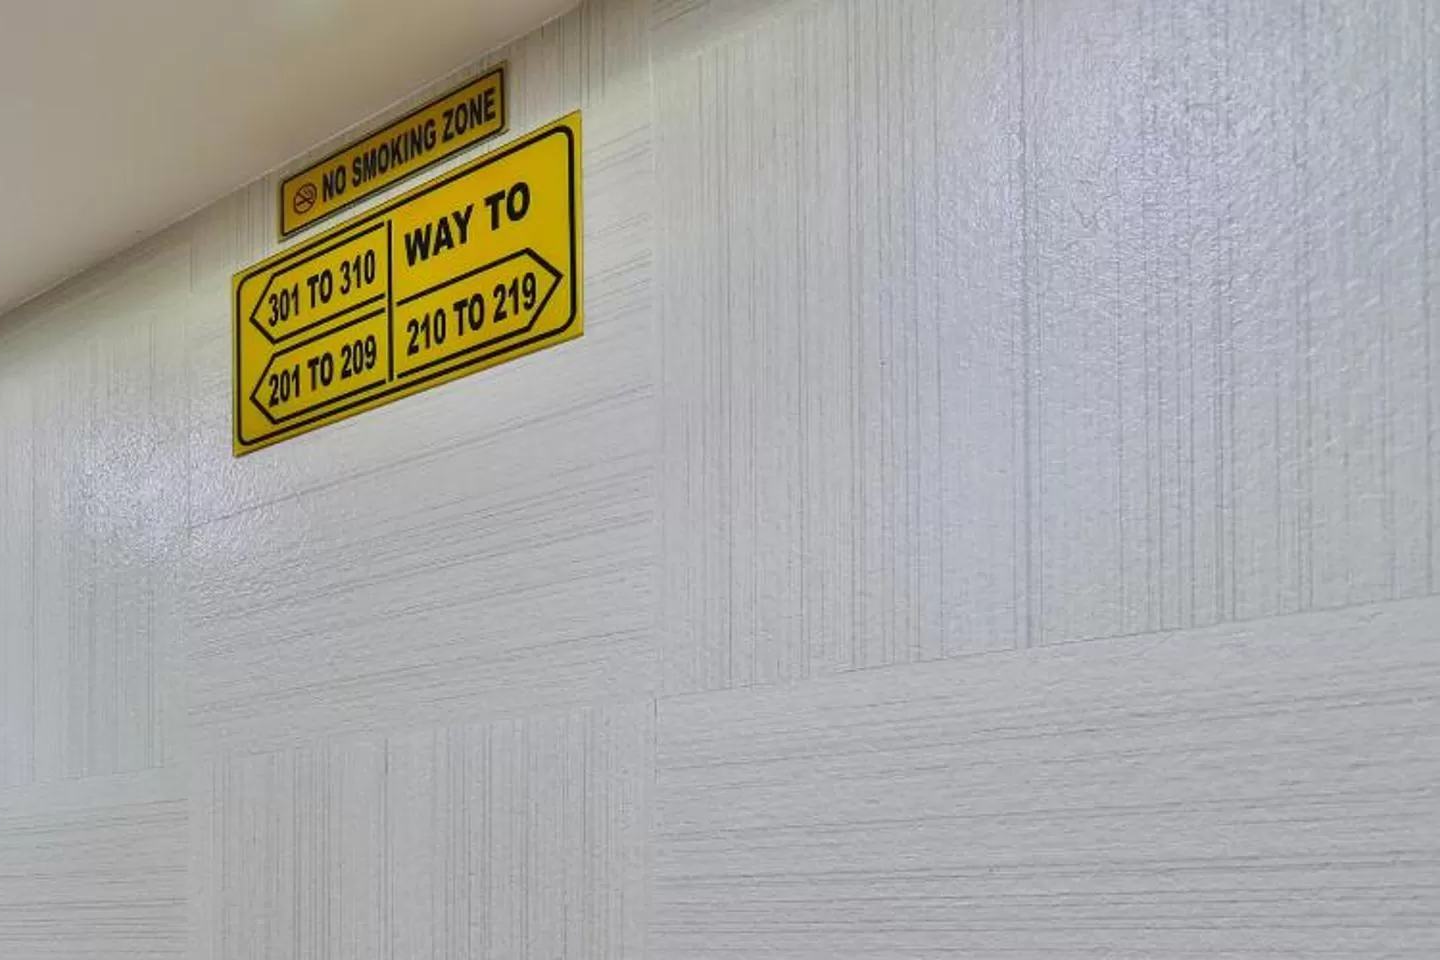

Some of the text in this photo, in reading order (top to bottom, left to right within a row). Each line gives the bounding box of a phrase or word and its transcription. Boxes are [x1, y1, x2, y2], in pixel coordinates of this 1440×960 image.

[322, 87, 497, 203] NO SMOKING ZONE
[404, 181, 531, 267] WAY TO
[268, 248, 376, 328] 301 TO 310
[406, 271, 537, 357] 210 TO 219
[268, 334, 377, 408] 201 TO 209
